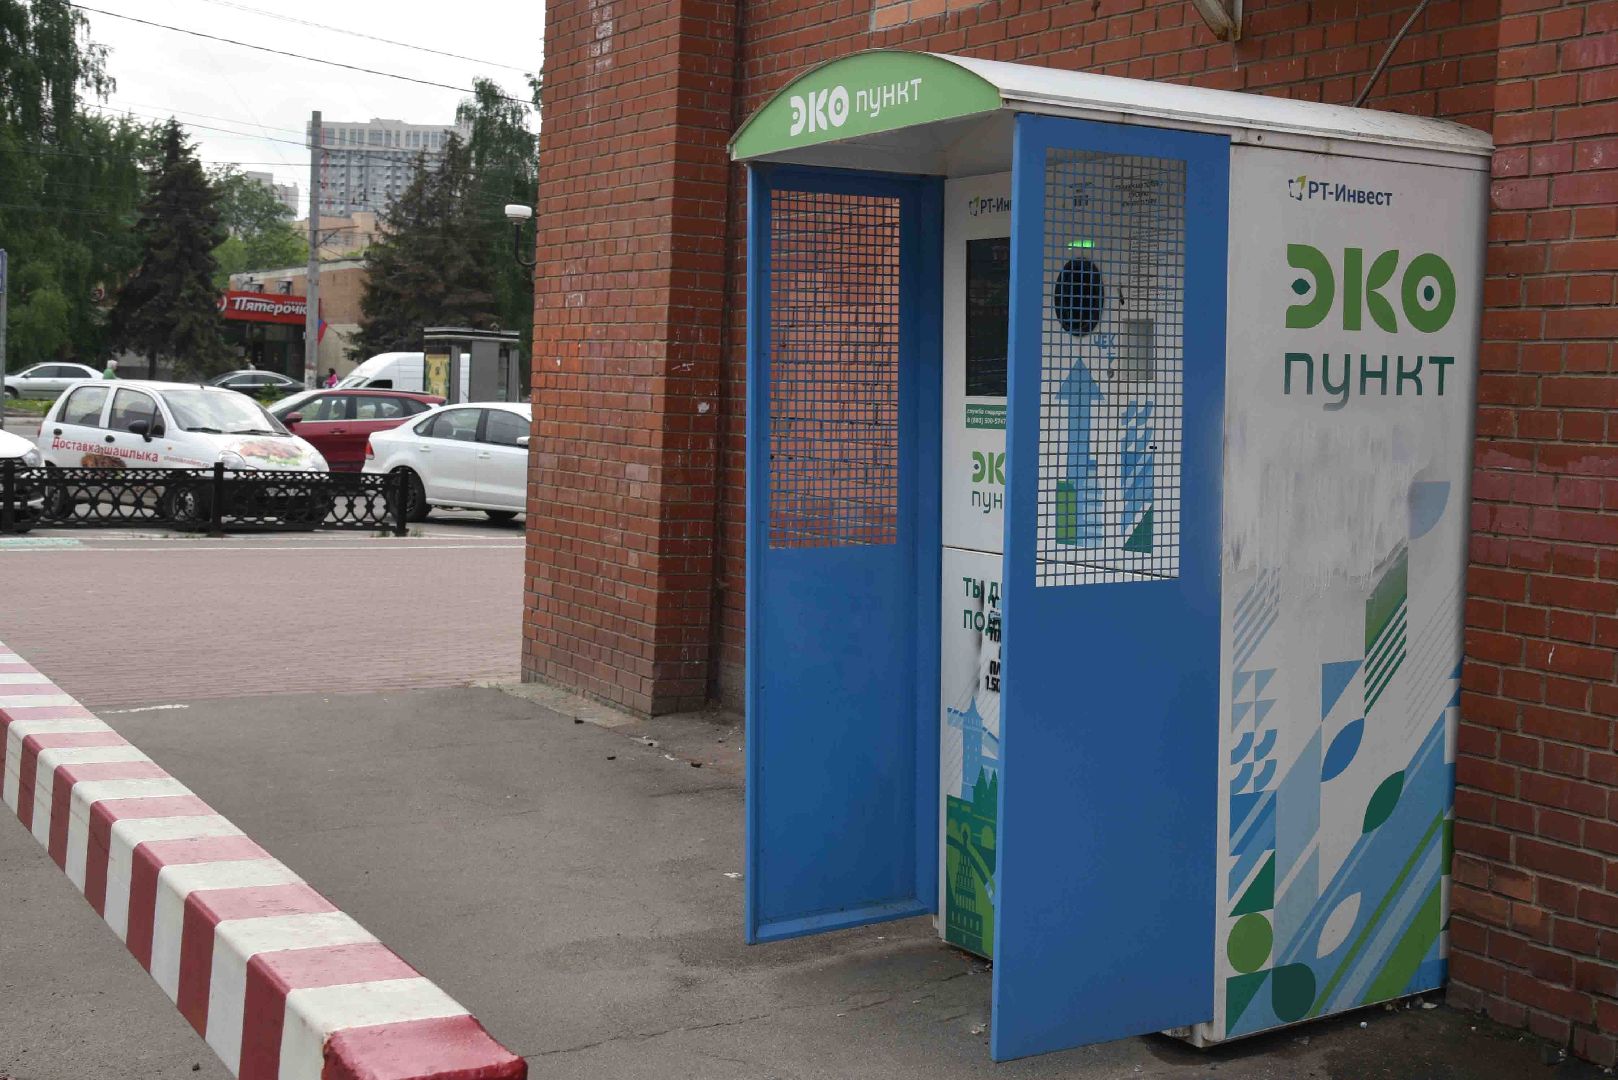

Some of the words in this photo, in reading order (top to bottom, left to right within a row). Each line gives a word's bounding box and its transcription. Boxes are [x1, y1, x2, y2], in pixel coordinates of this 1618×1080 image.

[790, 85, 849, 136] ЭКО
[856, 78, 922, 118] пункт
[980, 197, 1012, 214] РТ-Ин
[1308, 180, 1393, 206] РТ-Инвест
[1285, 243, 1456, 334] ЭКО
[230, 295, 308, 316] Пятерочк
[1284, 352, 1455, 411] пункт
[52, 436, 100, 454] Доставка
[103, 444, 159, 463] шашлыка
[972, 451, 1006, 486] ЭК
[971, 490, 1003, 514] пун
[988, 581, 1003, 604] Д
